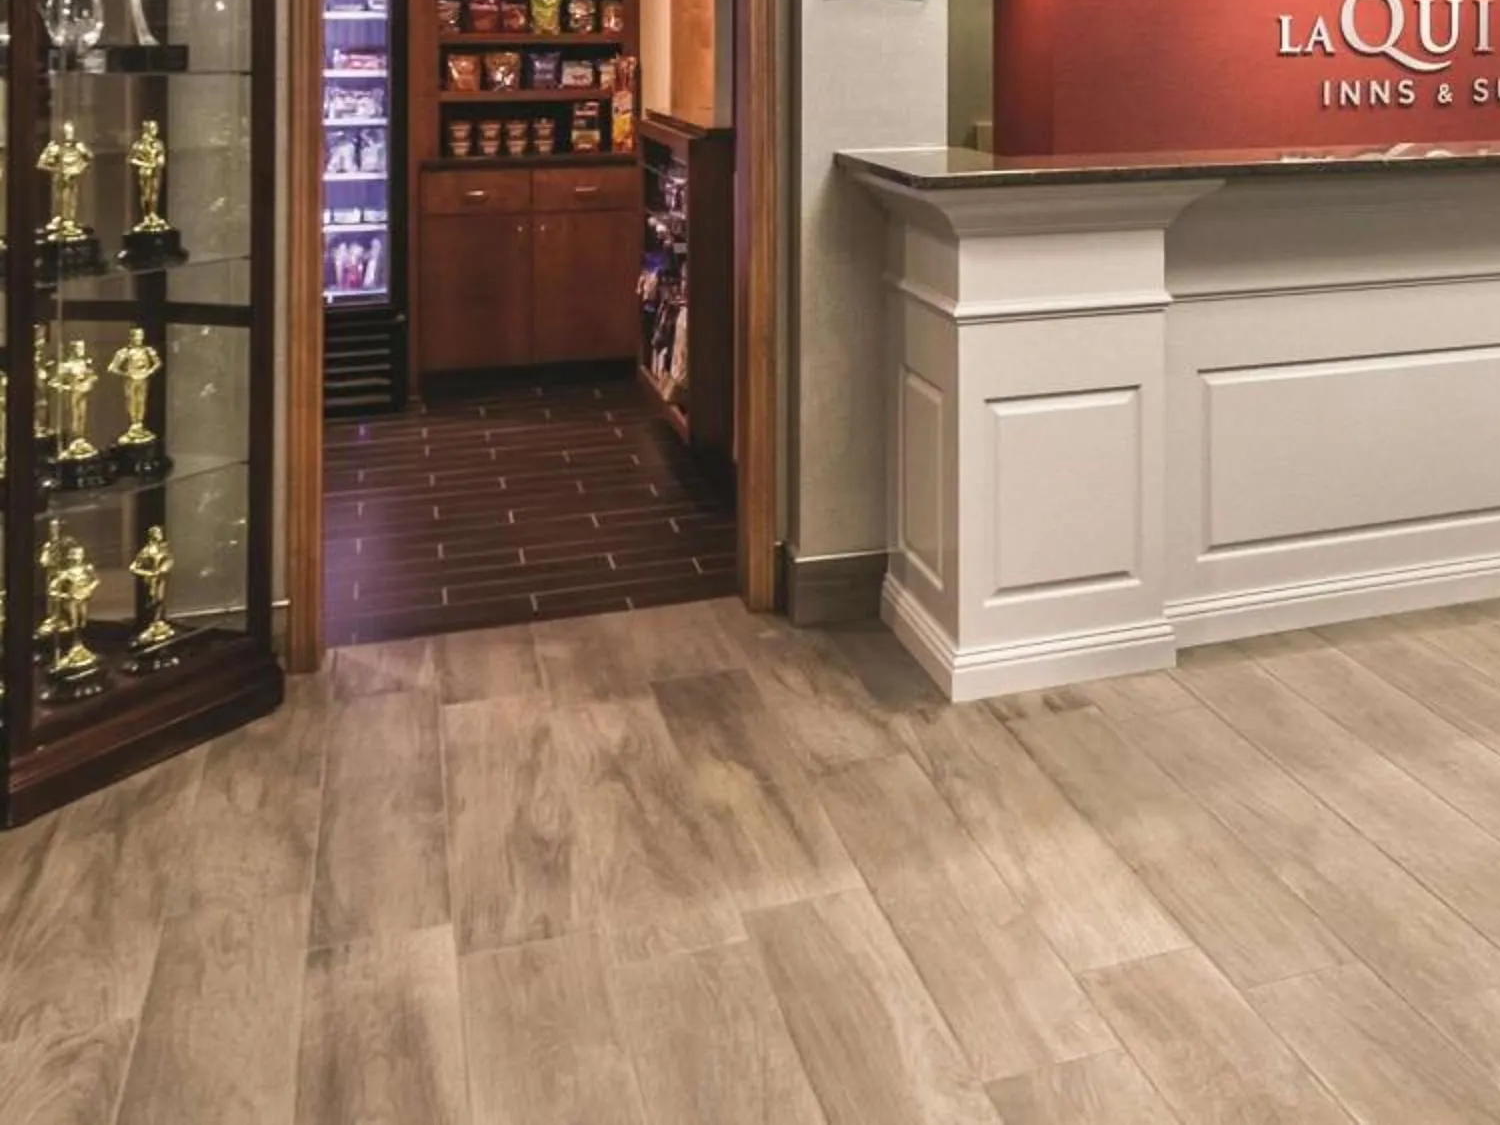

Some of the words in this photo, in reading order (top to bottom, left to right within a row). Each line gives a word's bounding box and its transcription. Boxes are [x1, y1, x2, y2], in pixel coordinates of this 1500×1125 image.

[1279, 13, 1336, 54] LA
[1322, 78, 1416, 107] INNS
[1436, 82, 1454, 105] &
